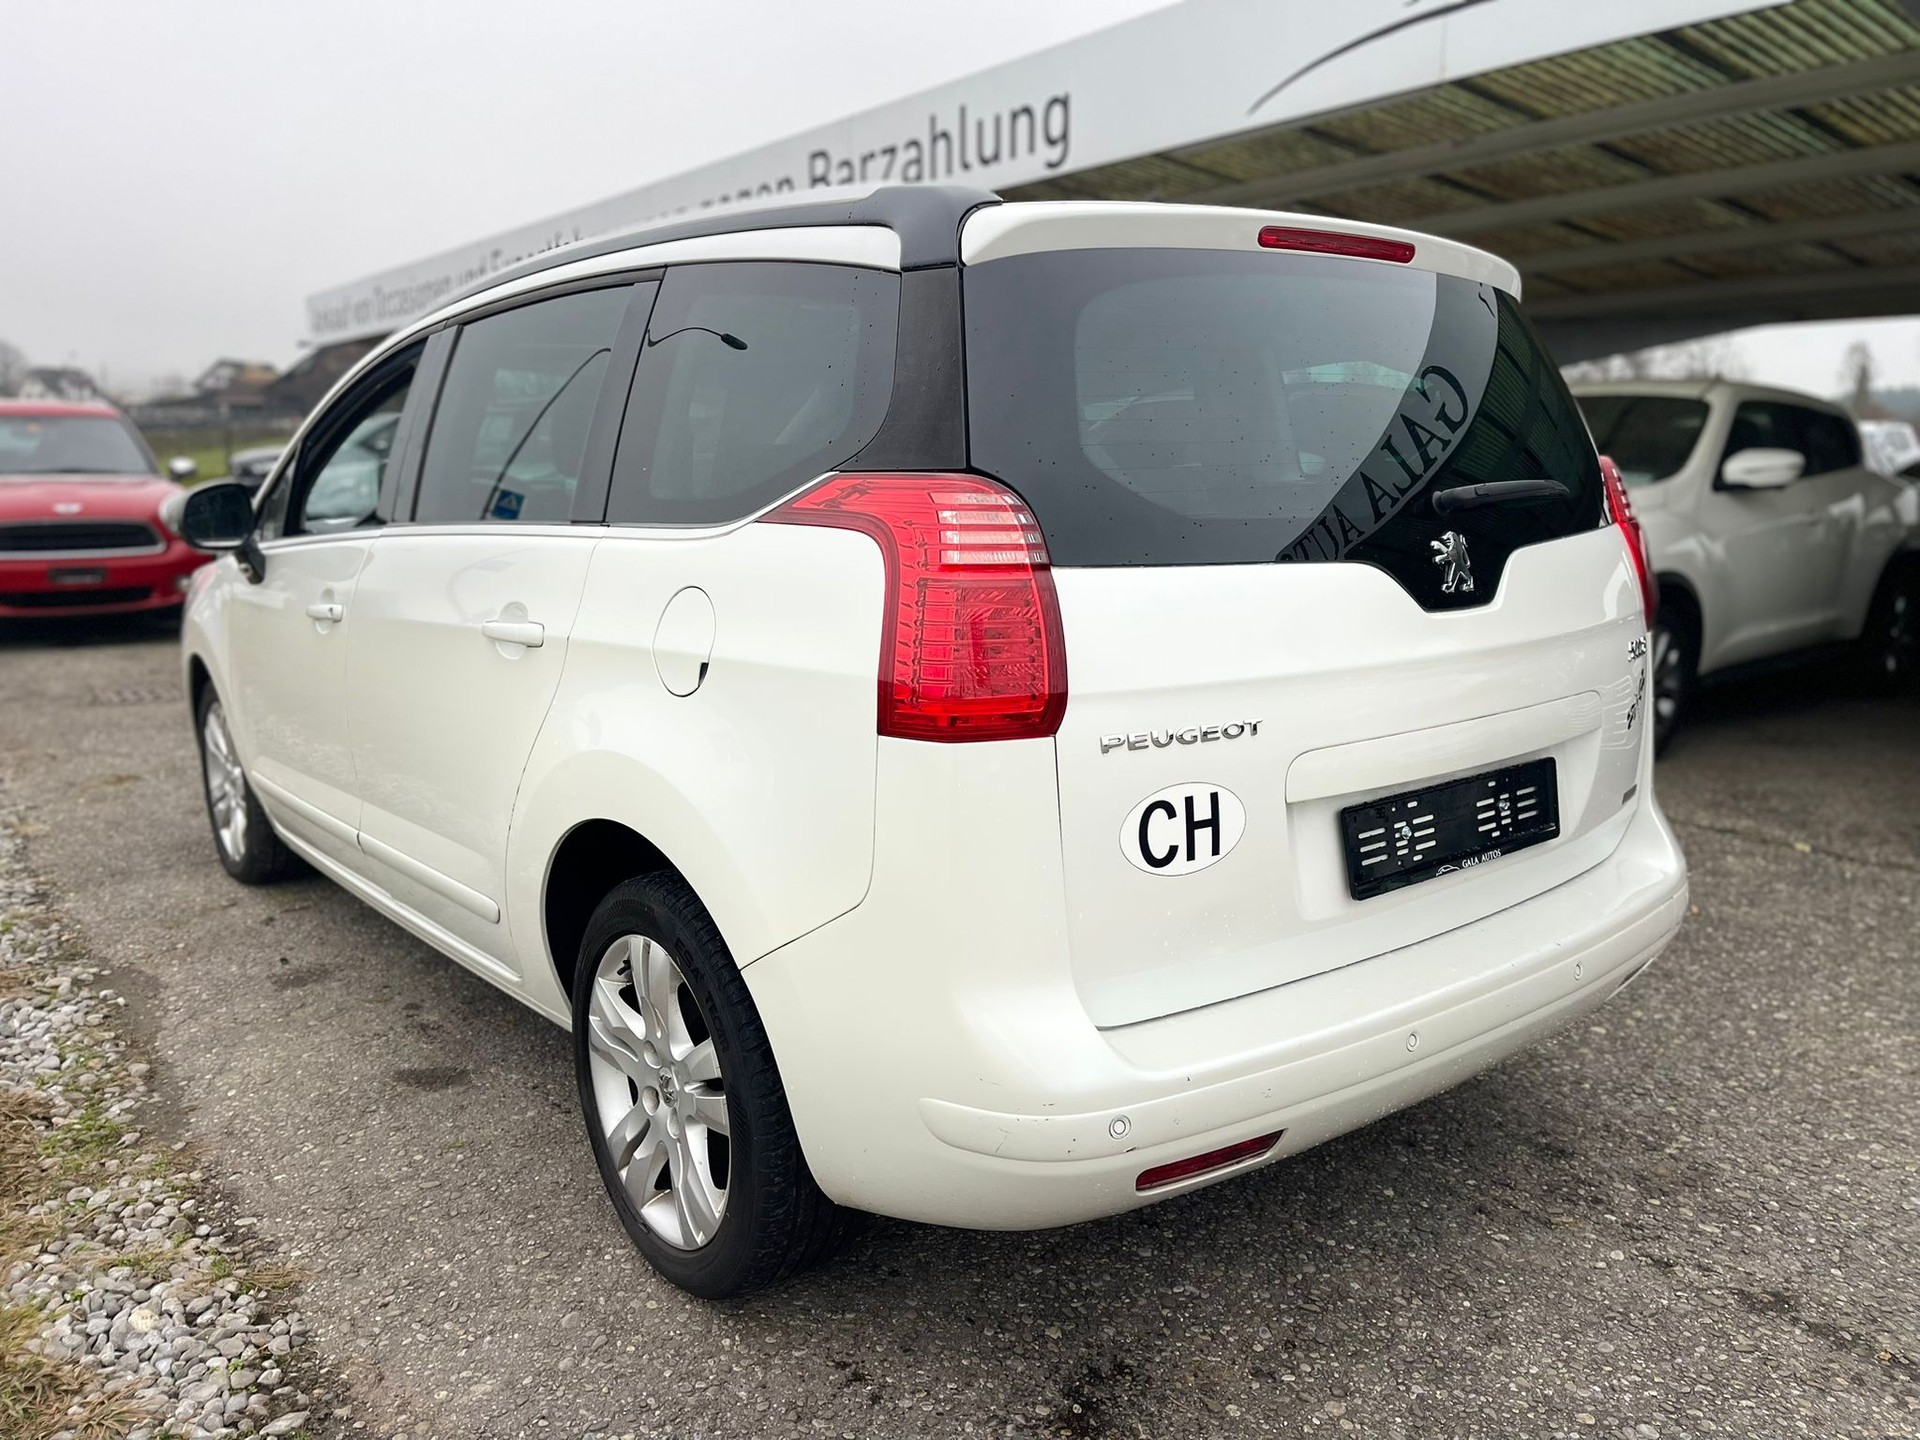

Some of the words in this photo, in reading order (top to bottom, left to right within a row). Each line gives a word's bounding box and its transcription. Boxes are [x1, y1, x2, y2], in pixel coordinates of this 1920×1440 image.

[808, 92, 1071, 188] Barzahlung
[1100, 718, 1264, 755] PEUGEOT
[1138, 791, 1221, 869] CH
[1461, 855, 1480, 869] GALA
[1481, 848, 1502, 863] AUTOS
